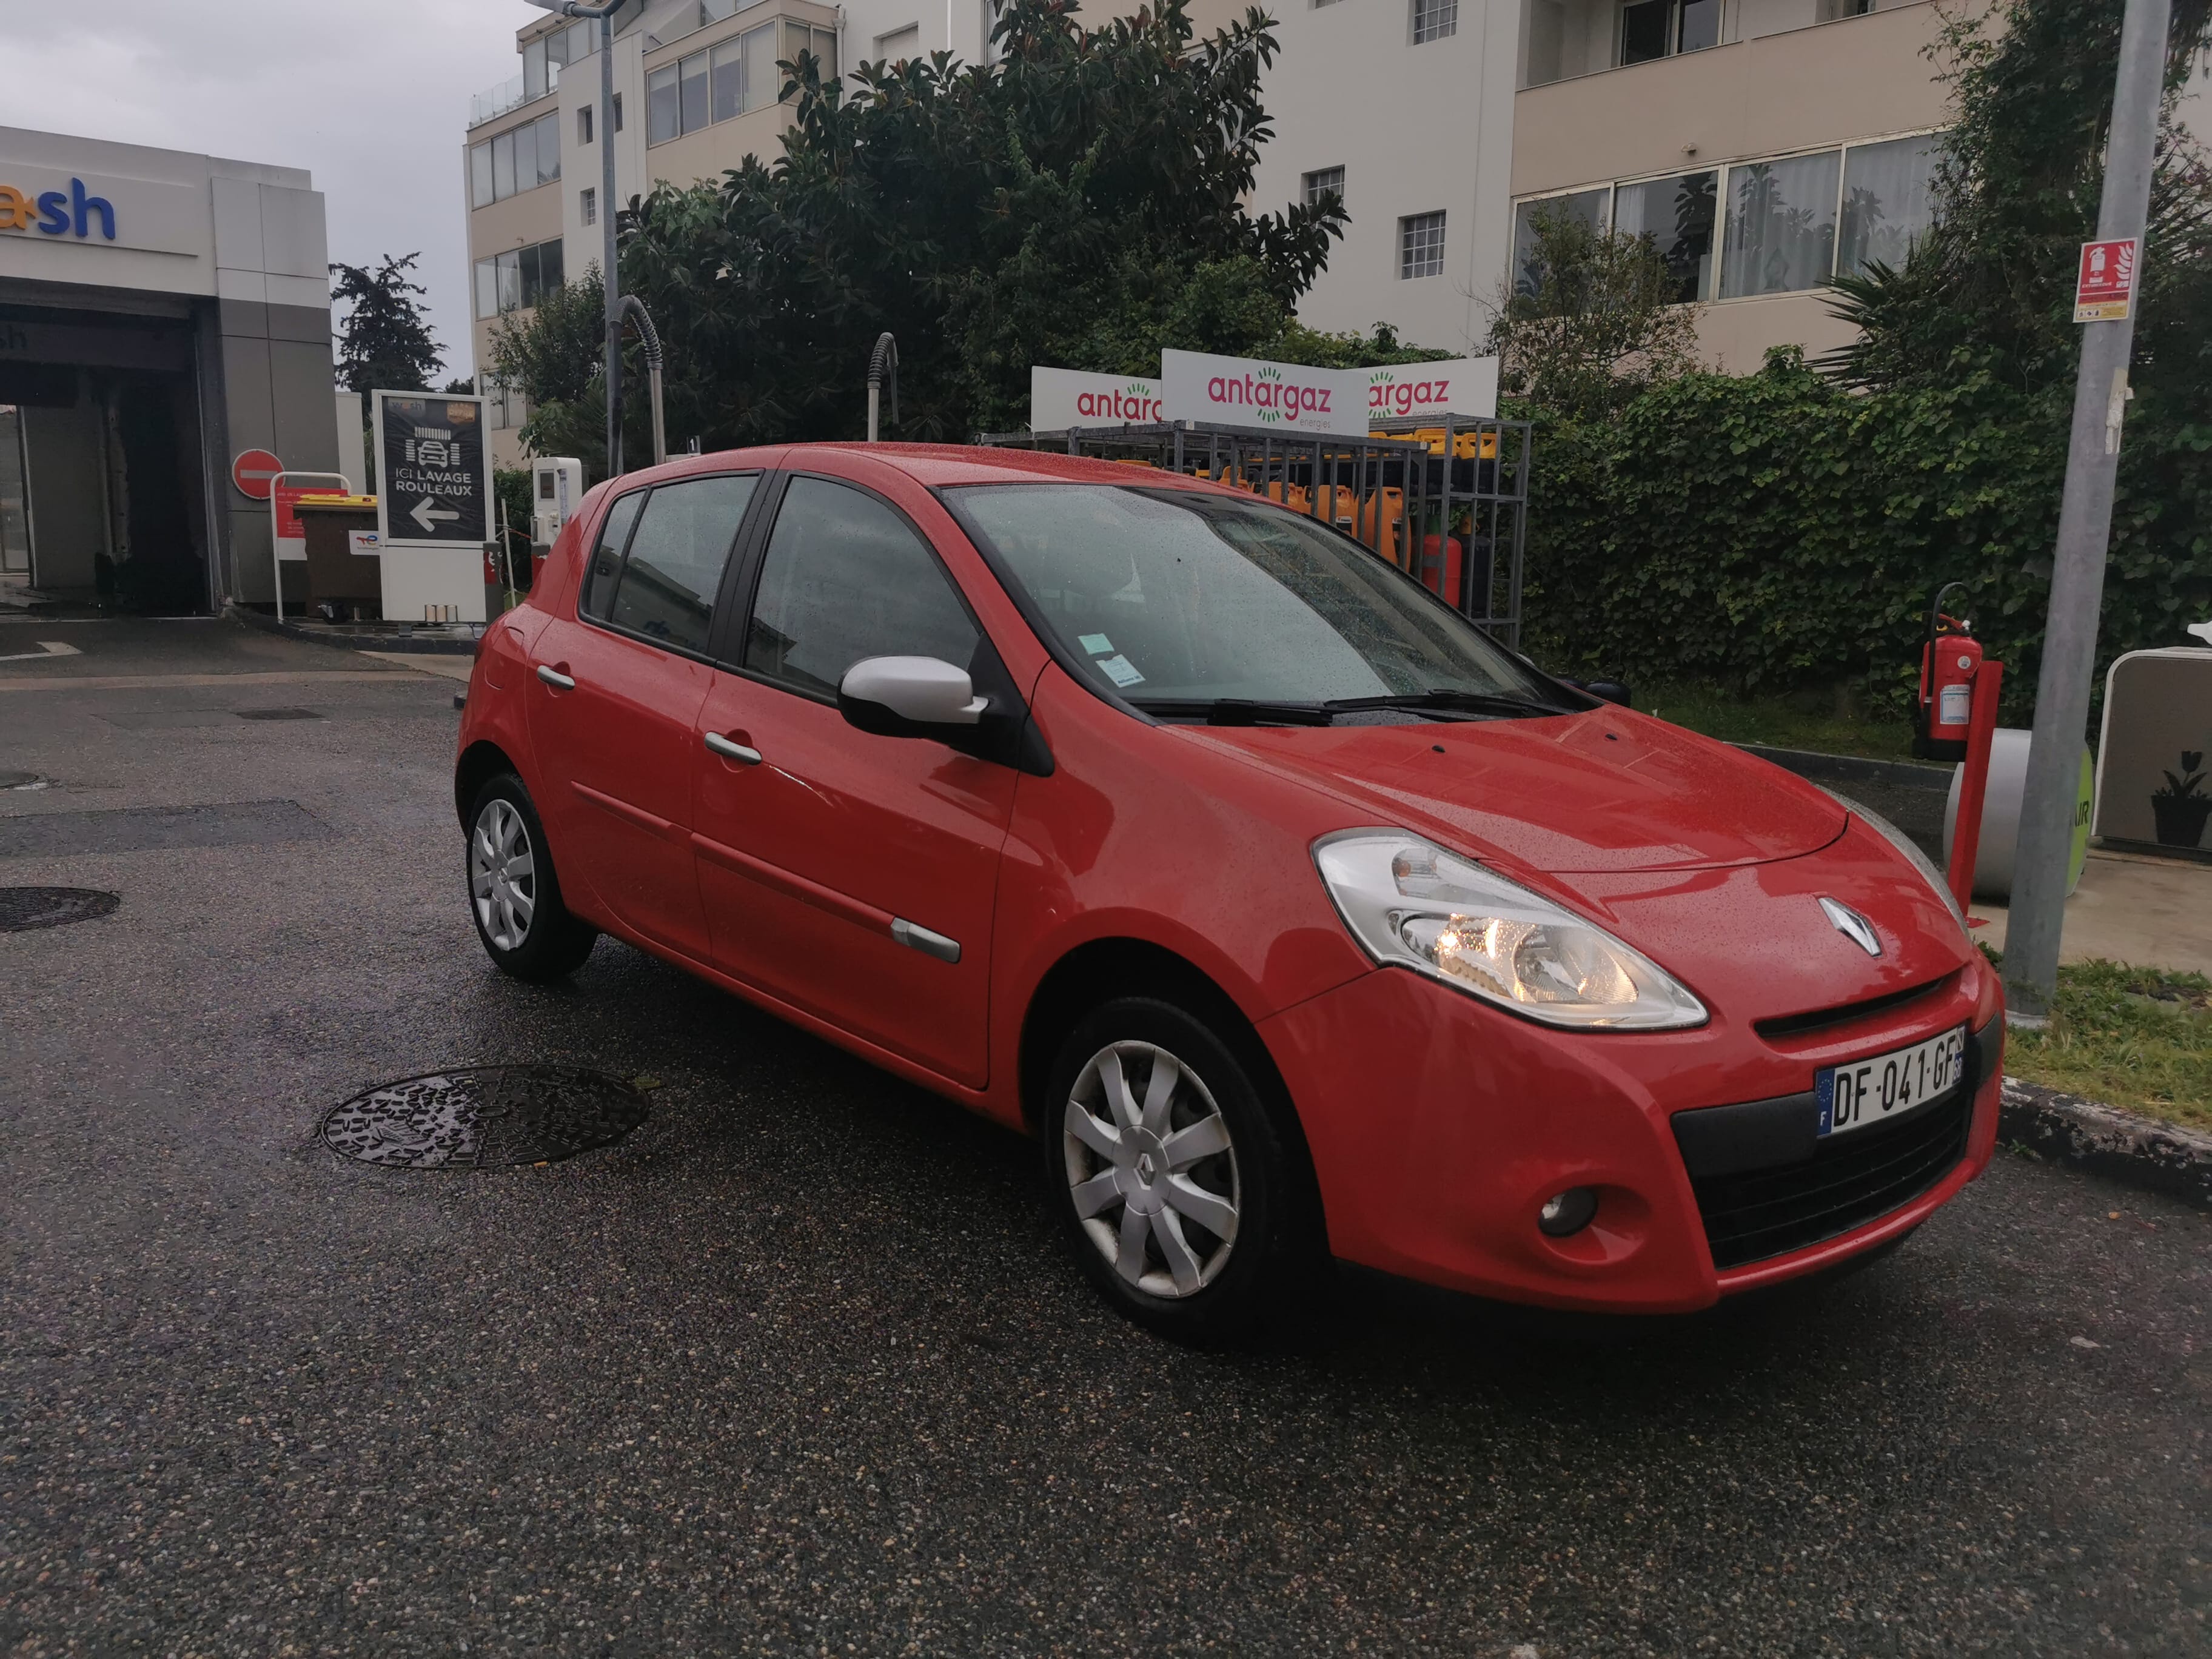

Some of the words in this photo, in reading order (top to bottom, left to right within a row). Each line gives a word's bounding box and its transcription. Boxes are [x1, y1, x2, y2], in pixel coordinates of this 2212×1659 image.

[1208, 374, 1332, 421] antargaz
[1299, 418, 1330, 431] energies
[689, 438, 694, 451] 1
[395, 468, 412, 479] ICI
[417, 470, 472, 483] LAVAGE
[396, 481, 472, 496] ROULEAUX
[1820, 1111, 1827, 1126] F
